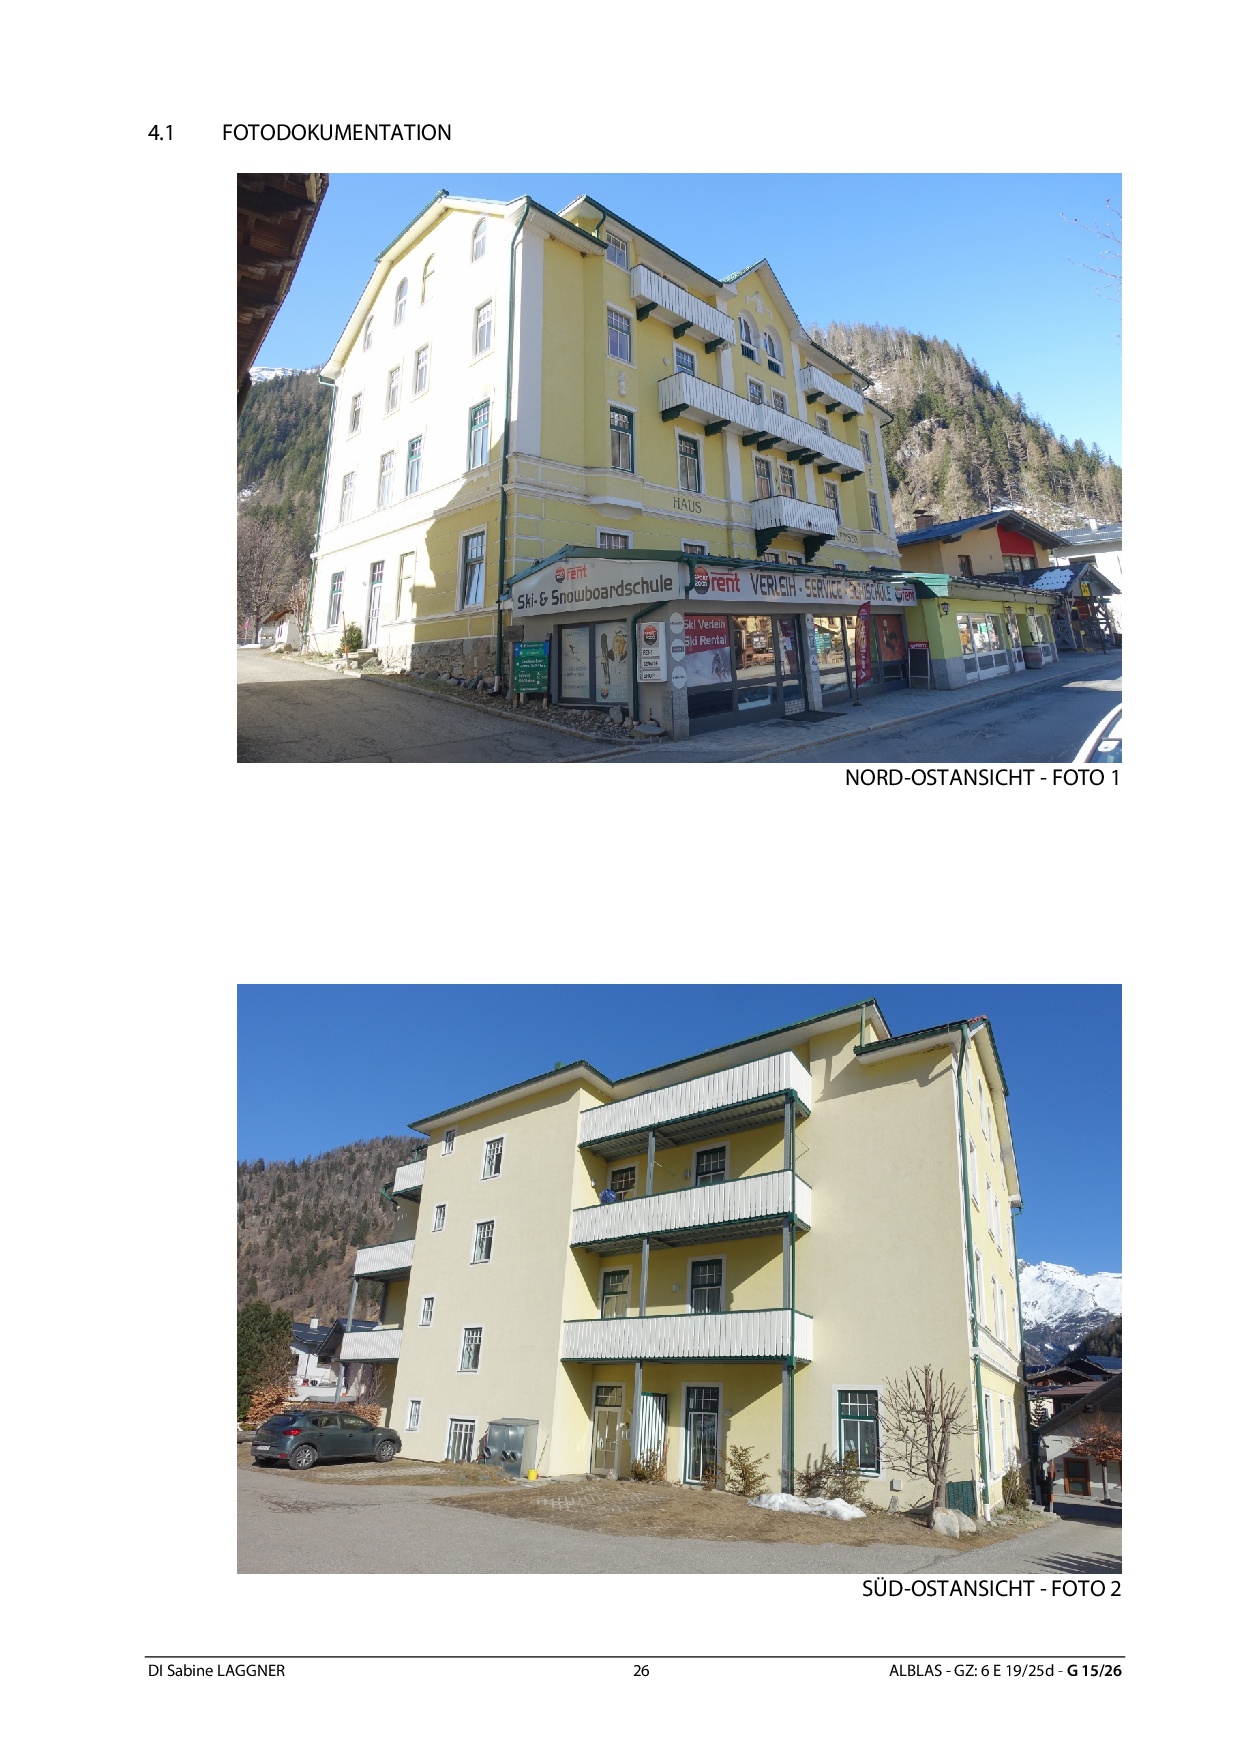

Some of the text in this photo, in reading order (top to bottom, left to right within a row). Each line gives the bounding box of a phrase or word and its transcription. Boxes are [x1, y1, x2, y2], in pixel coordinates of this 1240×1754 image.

[148, 124, 451, 141] 4.1 FOTODOKUMENTATION
[673, 497, 702, 513] HAUS
[566, 564, 587, 580] rent
[539, 591, 548, 607] &
[551, 574, 673, 606] Snowboardschule
[711, 572, 740, 593] rent
[750, 572, 796, 597] VERLEIH
[804, 578, 842, 600] SERVICE
[684, 619, 726, 630] Ski Verleih
[684, 634, 727, 646] Ski Rental
[846, 768, 1036, 786] NORD-OSTANSICHT
[1053, 768, 1105, 786] FOTO
[1110, 769, 1119, 786] 1
[862, 1576, 1036, 1597] SÜD-OSTANSICHT
[1052, 1579, 1106, 1597] FOTO
[1110, 1580, 1122, 1597] 2
[148, 1663, 286, 1677] DI Sabine LAGGNER
[633, 1664, 650, 1677] 26
[888, 1663, 943, 1677] ALBLAS
[953, 1664, 978, 1677] GZ:
[980, 1664, 990, 1677] 6
[993, 1664, 1002, 1677] E
[1006, 1663, 1054, 1678] 19/25d
[1066, 1664, 1078, 1677] G
[1082, 1663, 1123, 1678] 15/26
